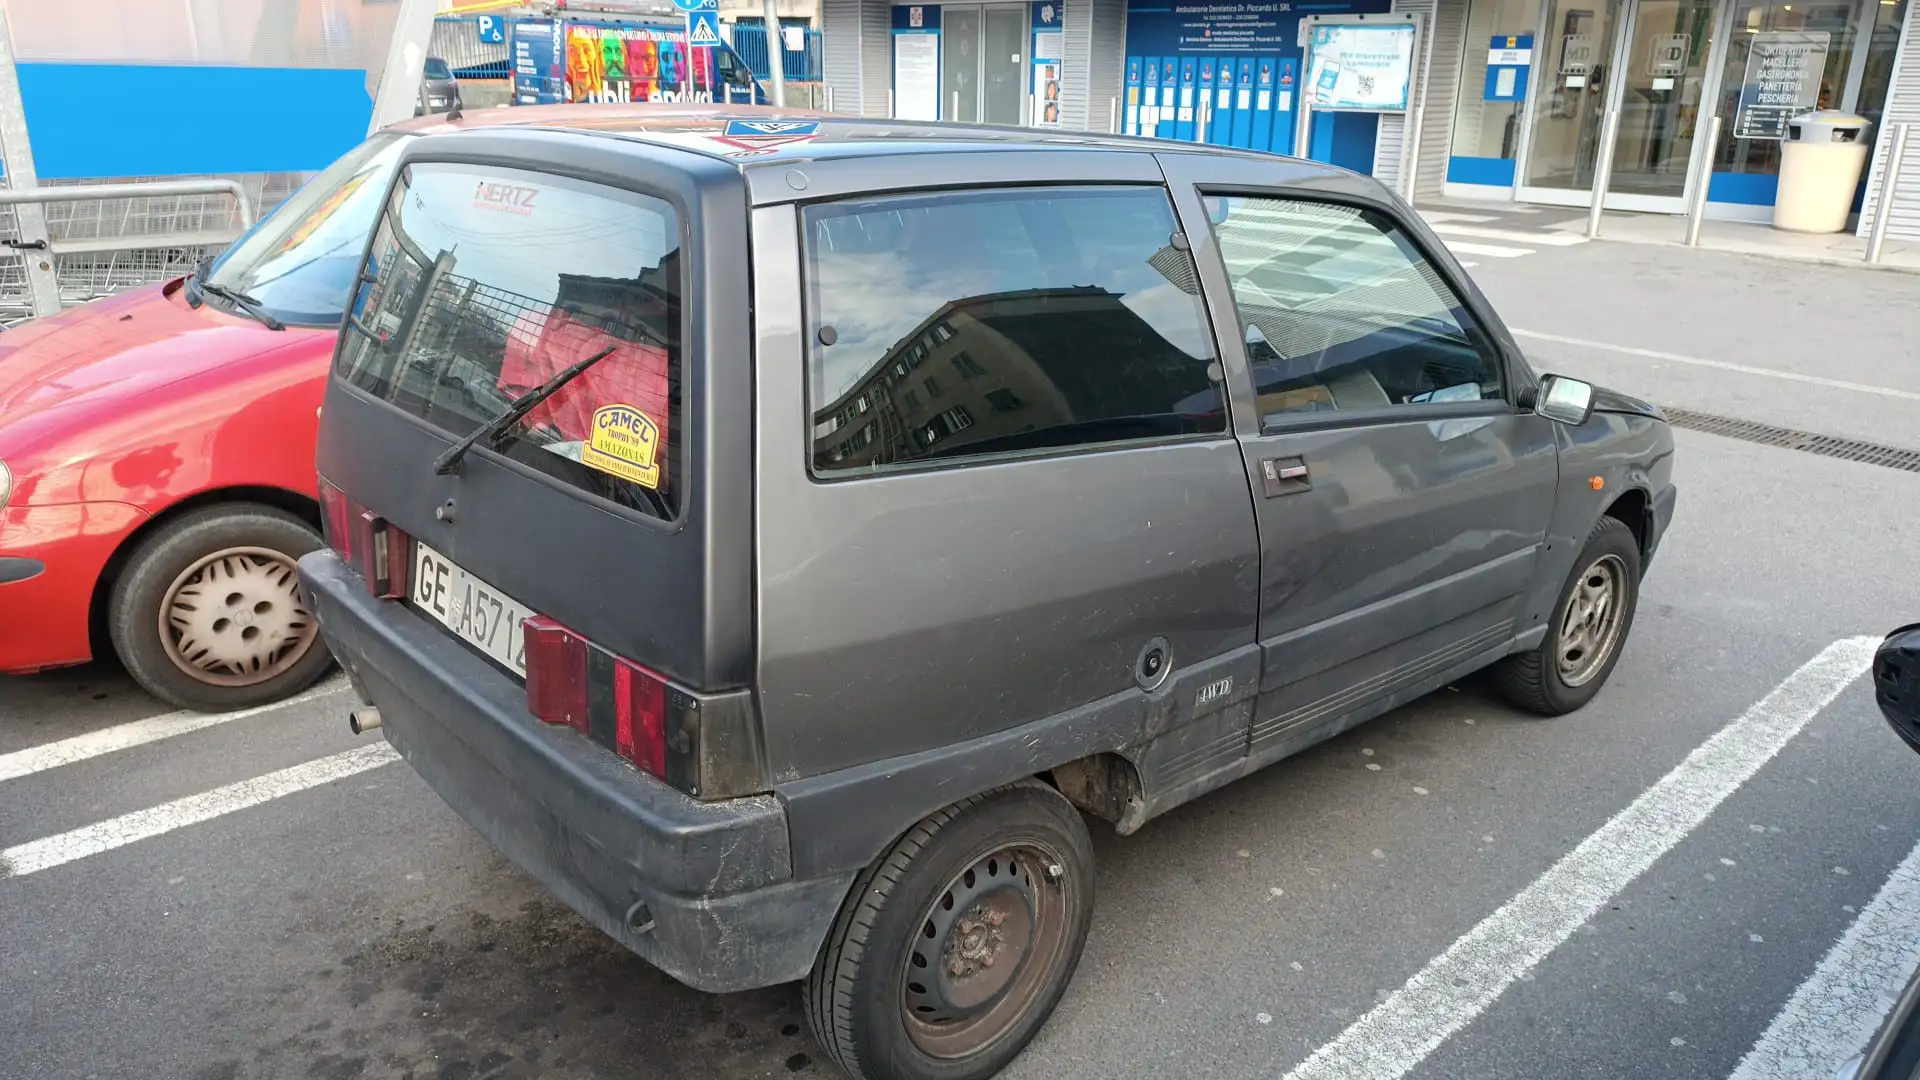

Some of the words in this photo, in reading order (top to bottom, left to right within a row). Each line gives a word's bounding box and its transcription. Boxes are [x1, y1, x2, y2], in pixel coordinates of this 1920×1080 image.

[479, 15, 493, 34] P
[1761, 57, 1808, 67] MACELLERIA
[1756, 69, 1809, 80] GASTRONOMIA
[1758, 81, 1802, 91] PANETTERIA
[1757, 93, 1799, 104] PESCHERIA
[599, 411, 649, 443] CAMEL
[597, 439, 645, 463] AMAZONAS
[420, 555, 449, 617] GE
[1200, 679, 1230, 702] 4WD
